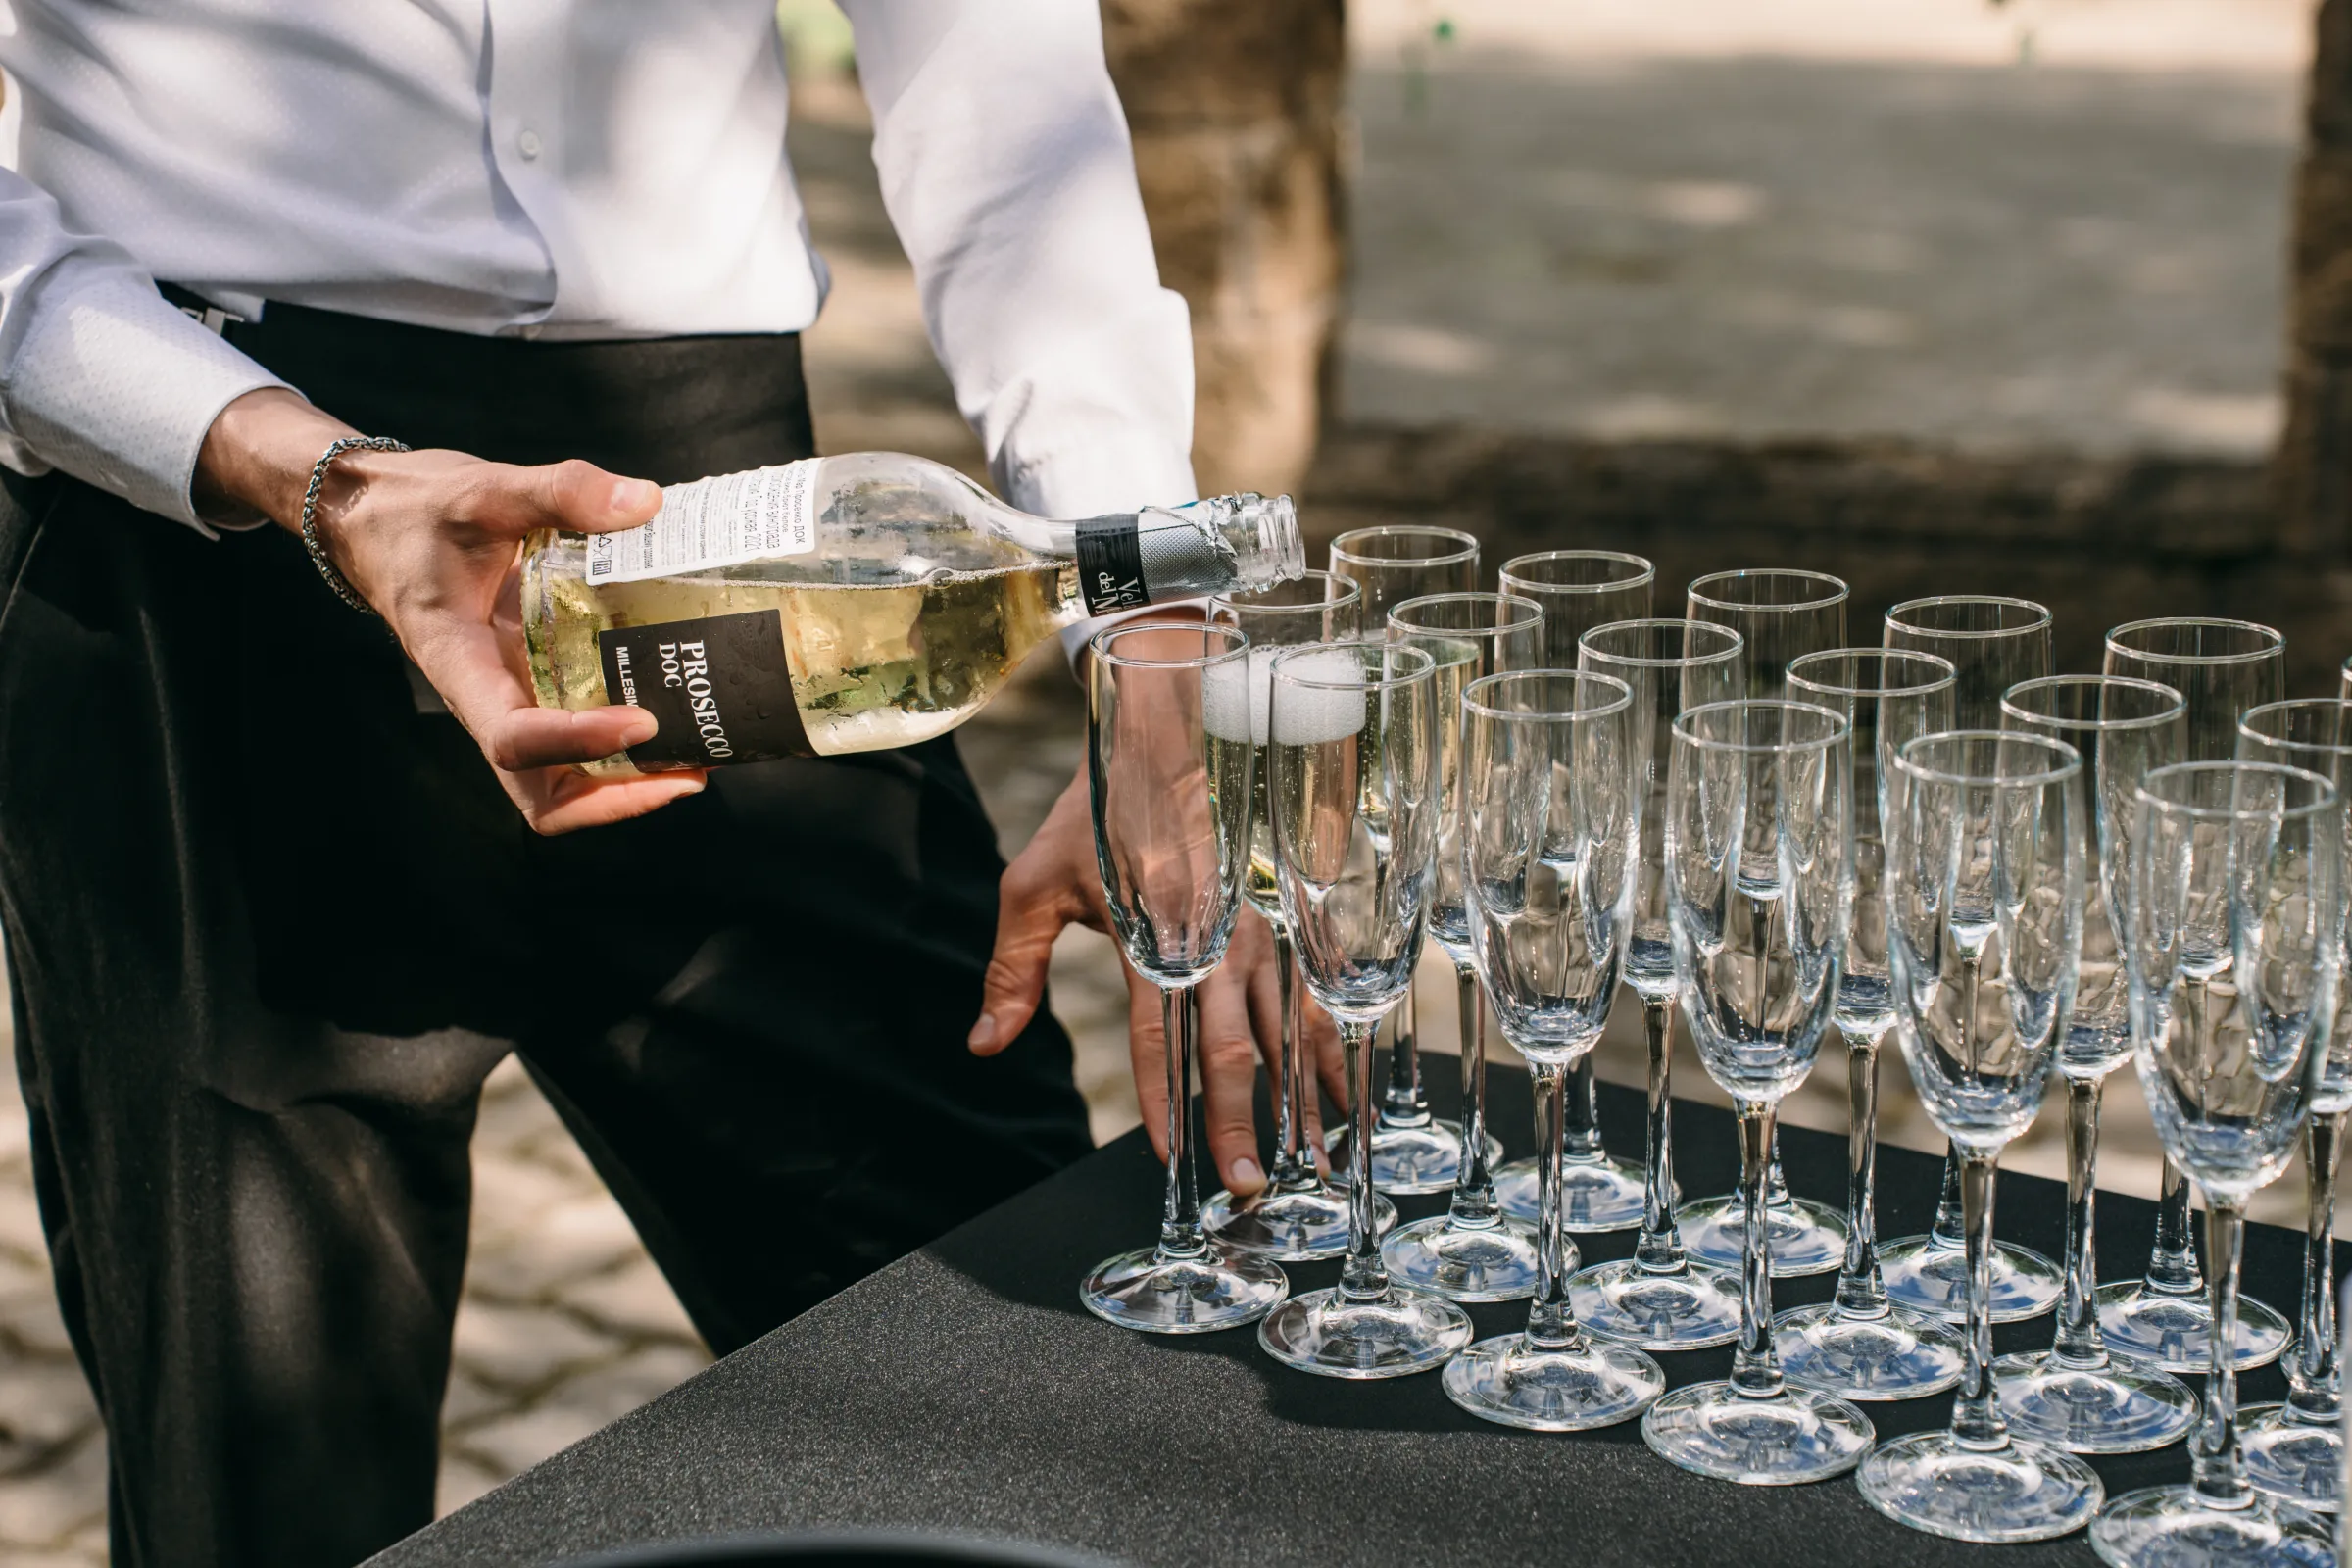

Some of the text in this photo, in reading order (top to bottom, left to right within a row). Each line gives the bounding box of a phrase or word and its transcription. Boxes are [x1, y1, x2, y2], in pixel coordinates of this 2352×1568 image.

[793, 490, 805, 524] Просекко
[781, 512, 791, 533] белое
[793, 525, 806, 545] ДОК
[744, 533, 761, 553] 2021
[1098, 571, 1117, 596] del
[659, 642, 683, 688] DOC
[679, 639, 734, 758] PROSECCO
